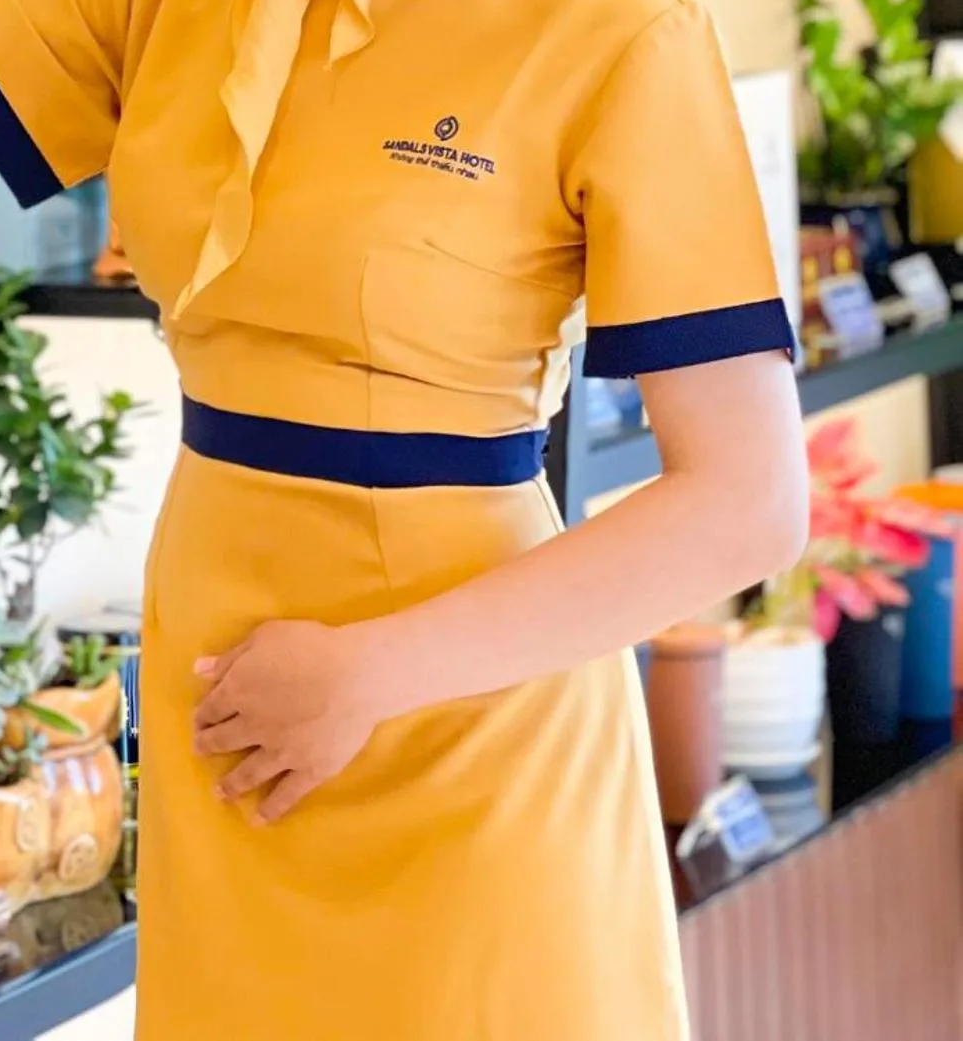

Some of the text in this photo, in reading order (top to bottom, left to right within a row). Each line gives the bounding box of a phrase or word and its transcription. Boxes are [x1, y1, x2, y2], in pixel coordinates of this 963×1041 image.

[382, 139, 495, 174] SANDALS VISTA HOTEL
